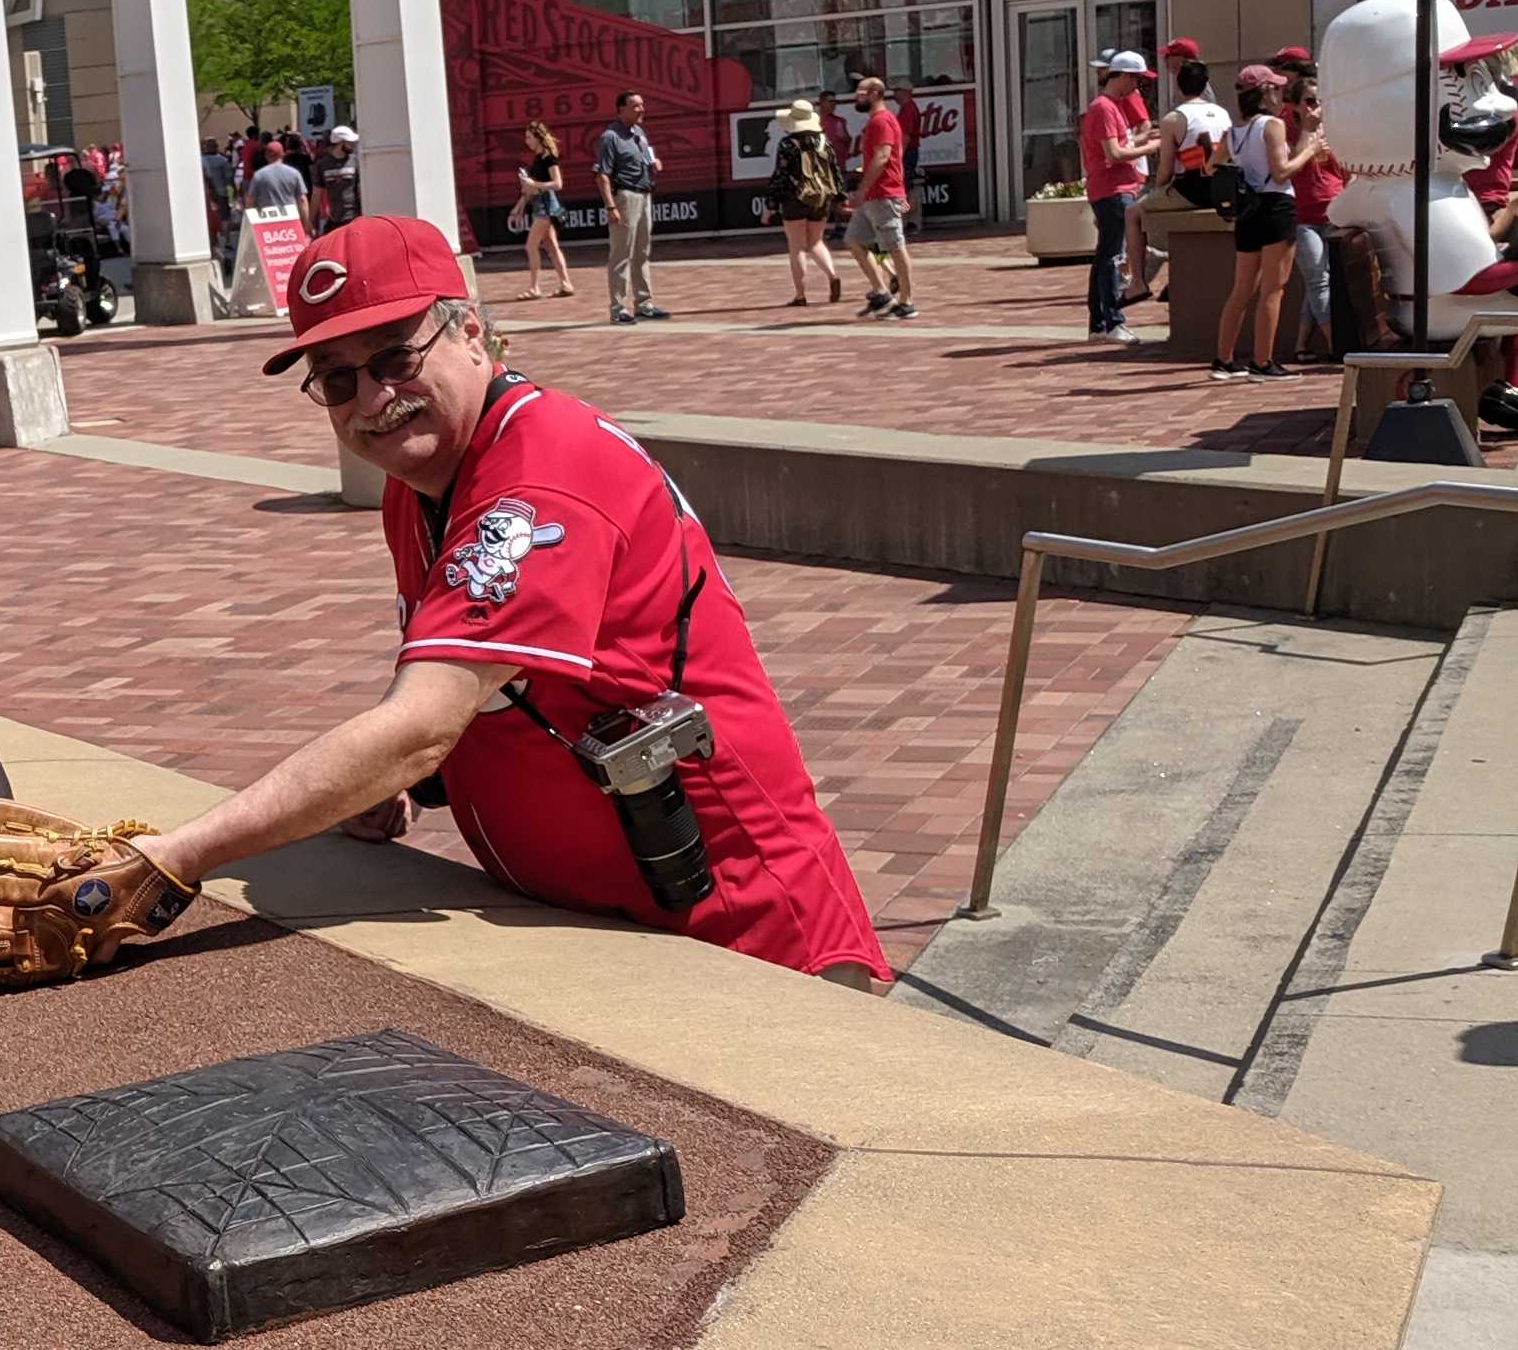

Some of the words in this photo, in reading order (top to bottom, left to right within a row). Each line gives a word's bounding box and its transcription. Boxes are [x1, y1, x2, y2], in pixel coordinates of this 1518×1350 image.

[543, 0, 701, 94] STOCKINGS
[506, 91, 600, 120] 1869
[262, 229, 297, 244] BAGS
